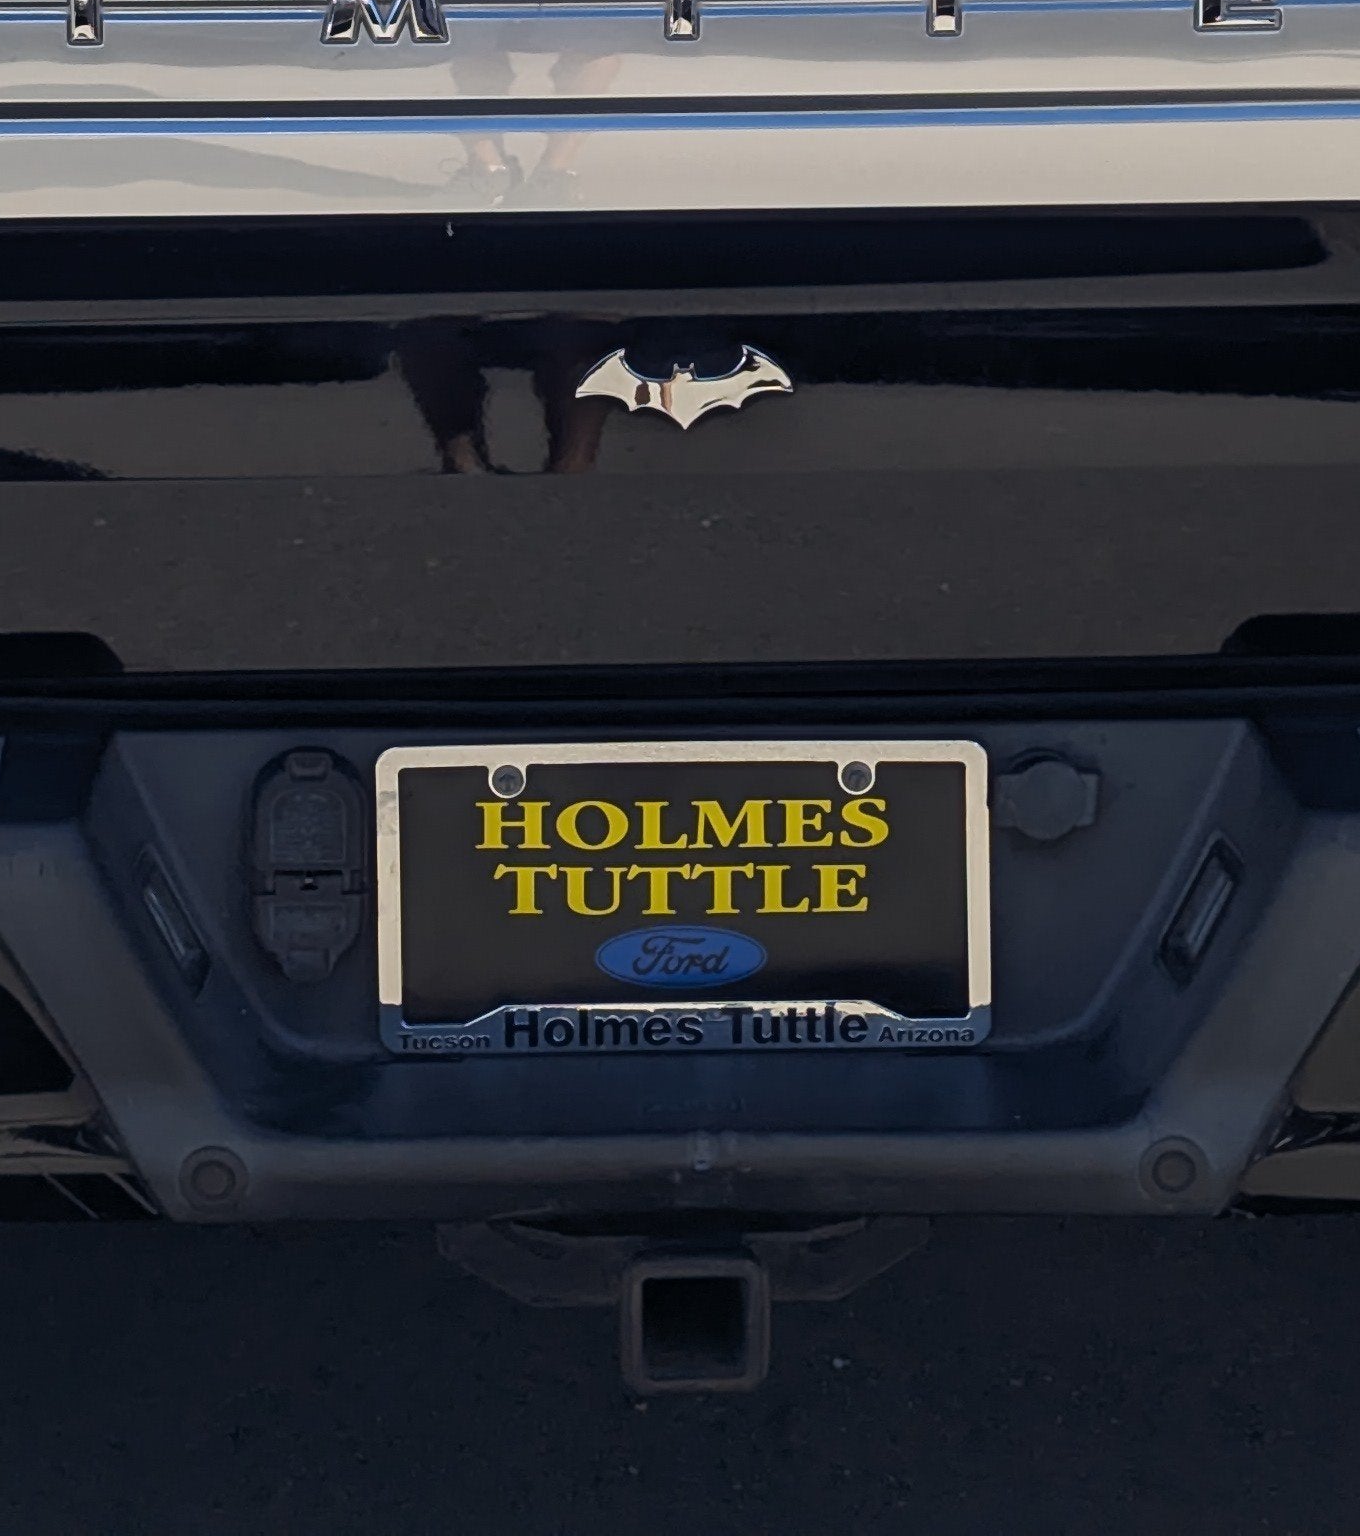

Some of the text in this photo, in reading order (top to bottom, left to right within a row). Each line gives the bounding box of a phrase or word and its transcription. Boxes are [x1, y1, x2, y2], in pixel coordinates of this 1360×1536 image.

[475, 798, 889, 850] HOLMES
[494, 863, 868, 916] TUTTLE
[632, 936, 730, 977] Ford
[399, 1033, 491, 1051] Tucson
[503, 1003, 869, 1049] Holmes Tuttle
[877, 1025, 976, 1043] Arizona
